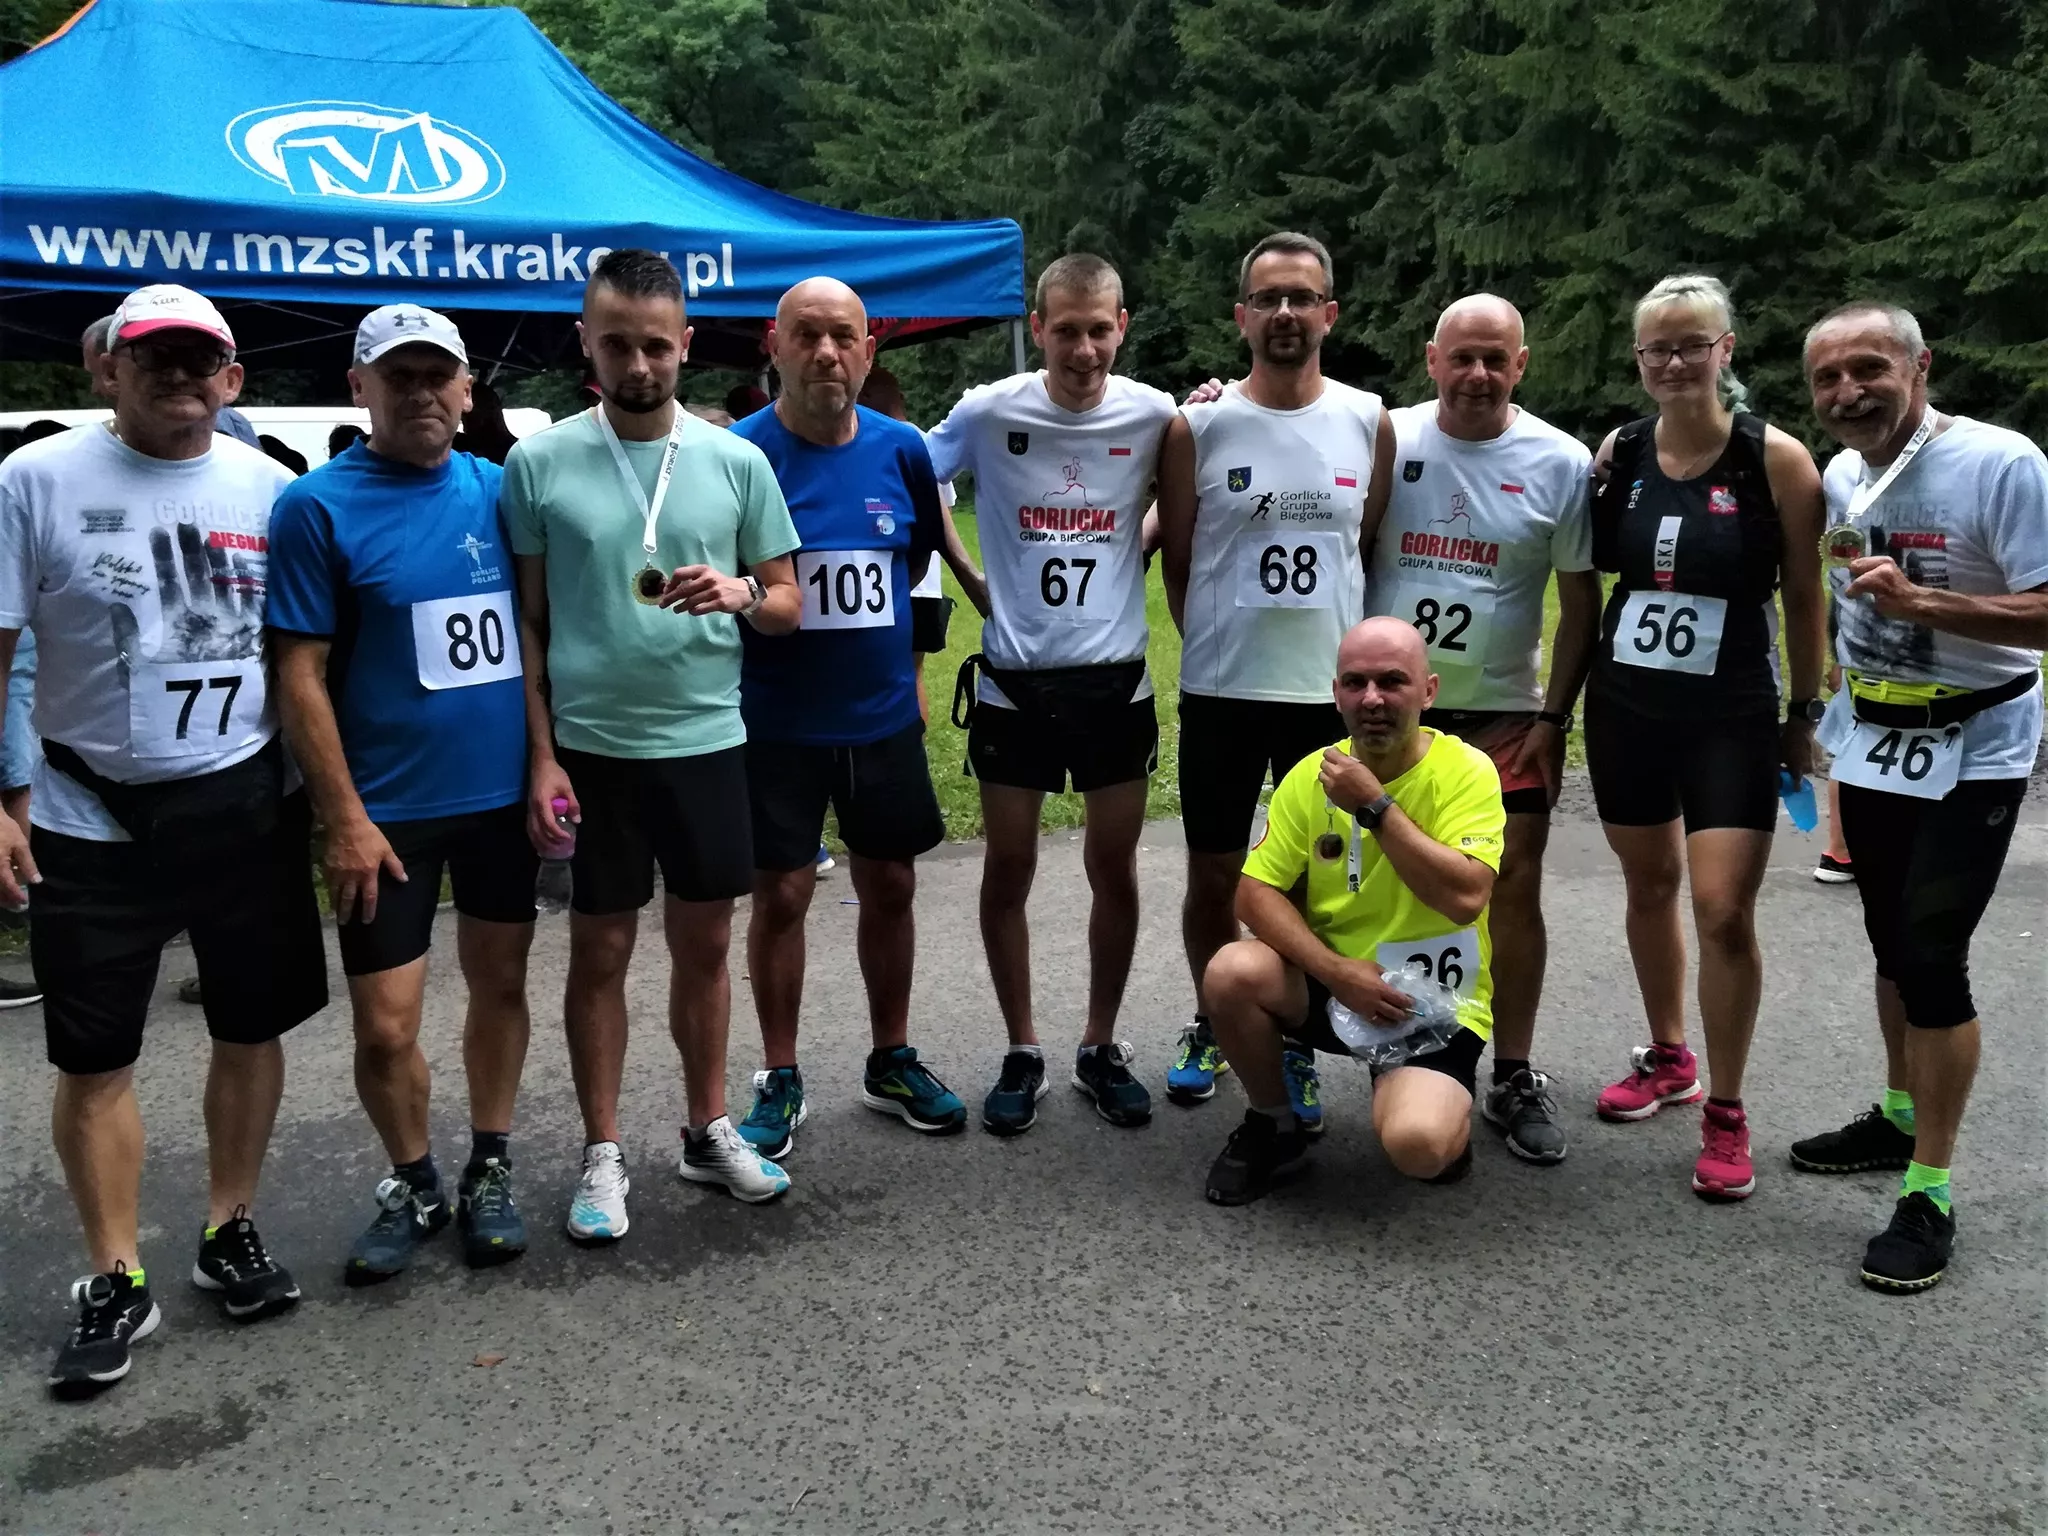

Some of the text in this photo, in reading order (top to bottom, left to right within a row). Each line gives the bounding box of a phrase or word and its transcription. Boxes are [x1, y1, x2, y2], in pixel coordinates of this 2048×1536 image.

[1280, 491, 1331, 500] Gorlicka
[1280, 502, 1318, 513] Grupa
[1019, 506, 1116, 531] GORLICKA
[1019, 531, 1111, 543] GRUPA BIEGOWA
[1280, 512, 1333, 523] Biegowa
[1259, 544, 1318, 595] 68
[1399, 557, 1493, 579] GRUPA BIEGOWA
[1400, 531, 1500, 566] GORLICKA
[471, 573, 502, 585] POLAND
[809, 562, 886, 616] 103
[1040, 557, 1097, 607] 67
[446, 608, 505, 671] 80
[1411, 597, 1473, 652] 82
[1633, 603, 1699, 658] 56
[165, 675, 243, 740] 77
[1865, 729, 1939, 781] 46
